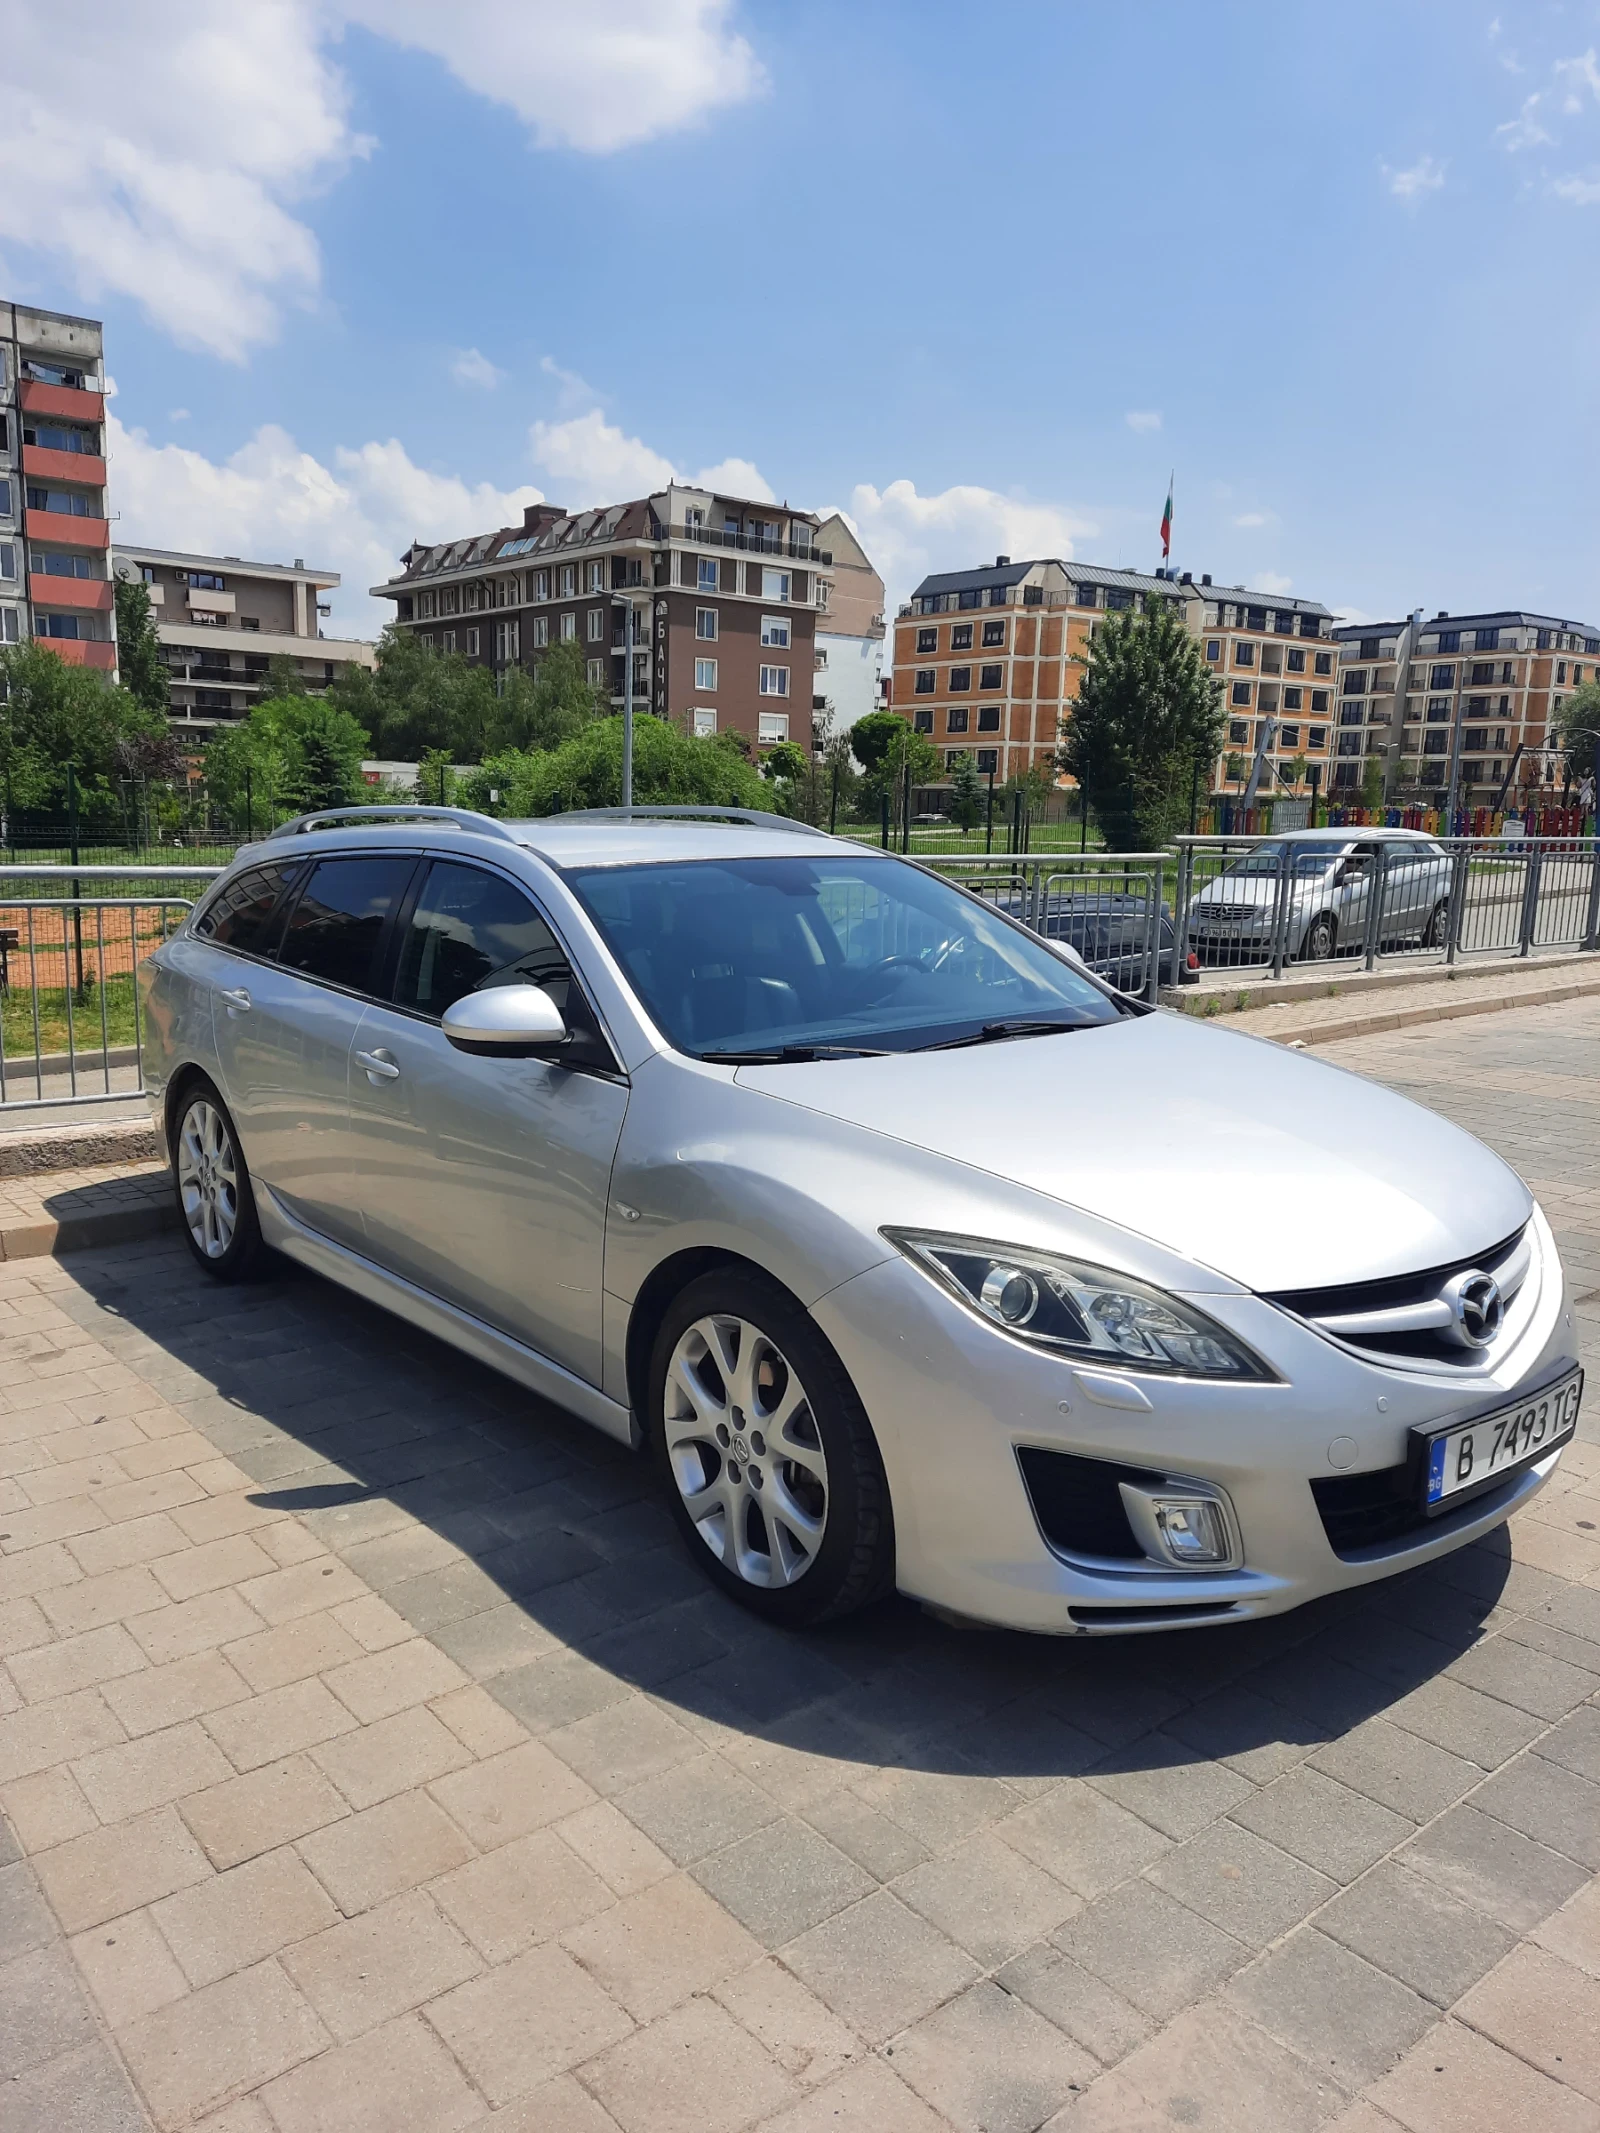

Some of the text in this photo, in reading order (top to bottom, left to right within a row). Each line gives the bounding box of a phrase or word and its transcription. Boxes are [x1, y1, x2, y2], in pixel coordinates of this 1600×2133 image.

[1457, 1381, 1577, 1482] B 7493 TC
[1429, 1476, 1442, 1492] BG
